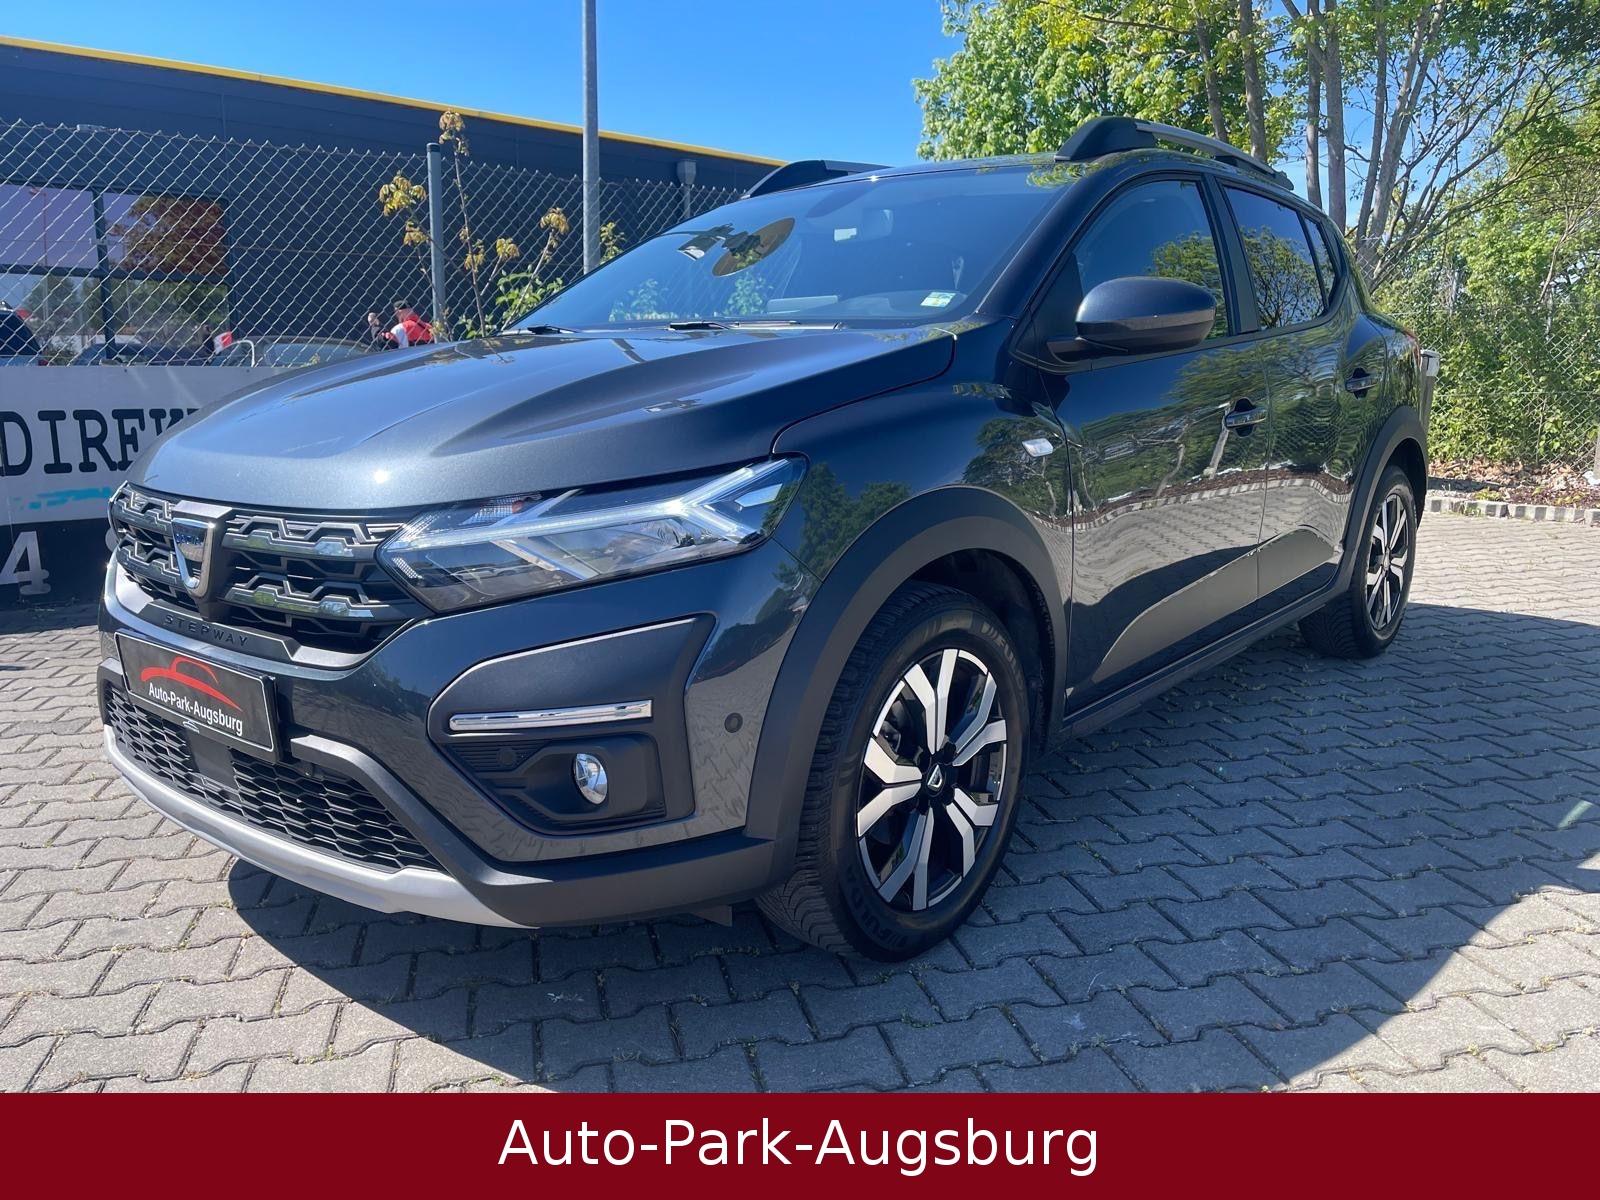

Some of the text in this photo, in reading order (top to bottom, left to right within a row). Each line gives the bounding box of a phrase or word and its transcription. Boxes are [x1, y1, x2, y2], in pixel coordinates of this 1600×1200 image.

[0, 408, 200, 476] DIRE
[164, 614, 248, 647] STEPWAY
[149, 682, 244, 737] Auto-Park-Augsburg
